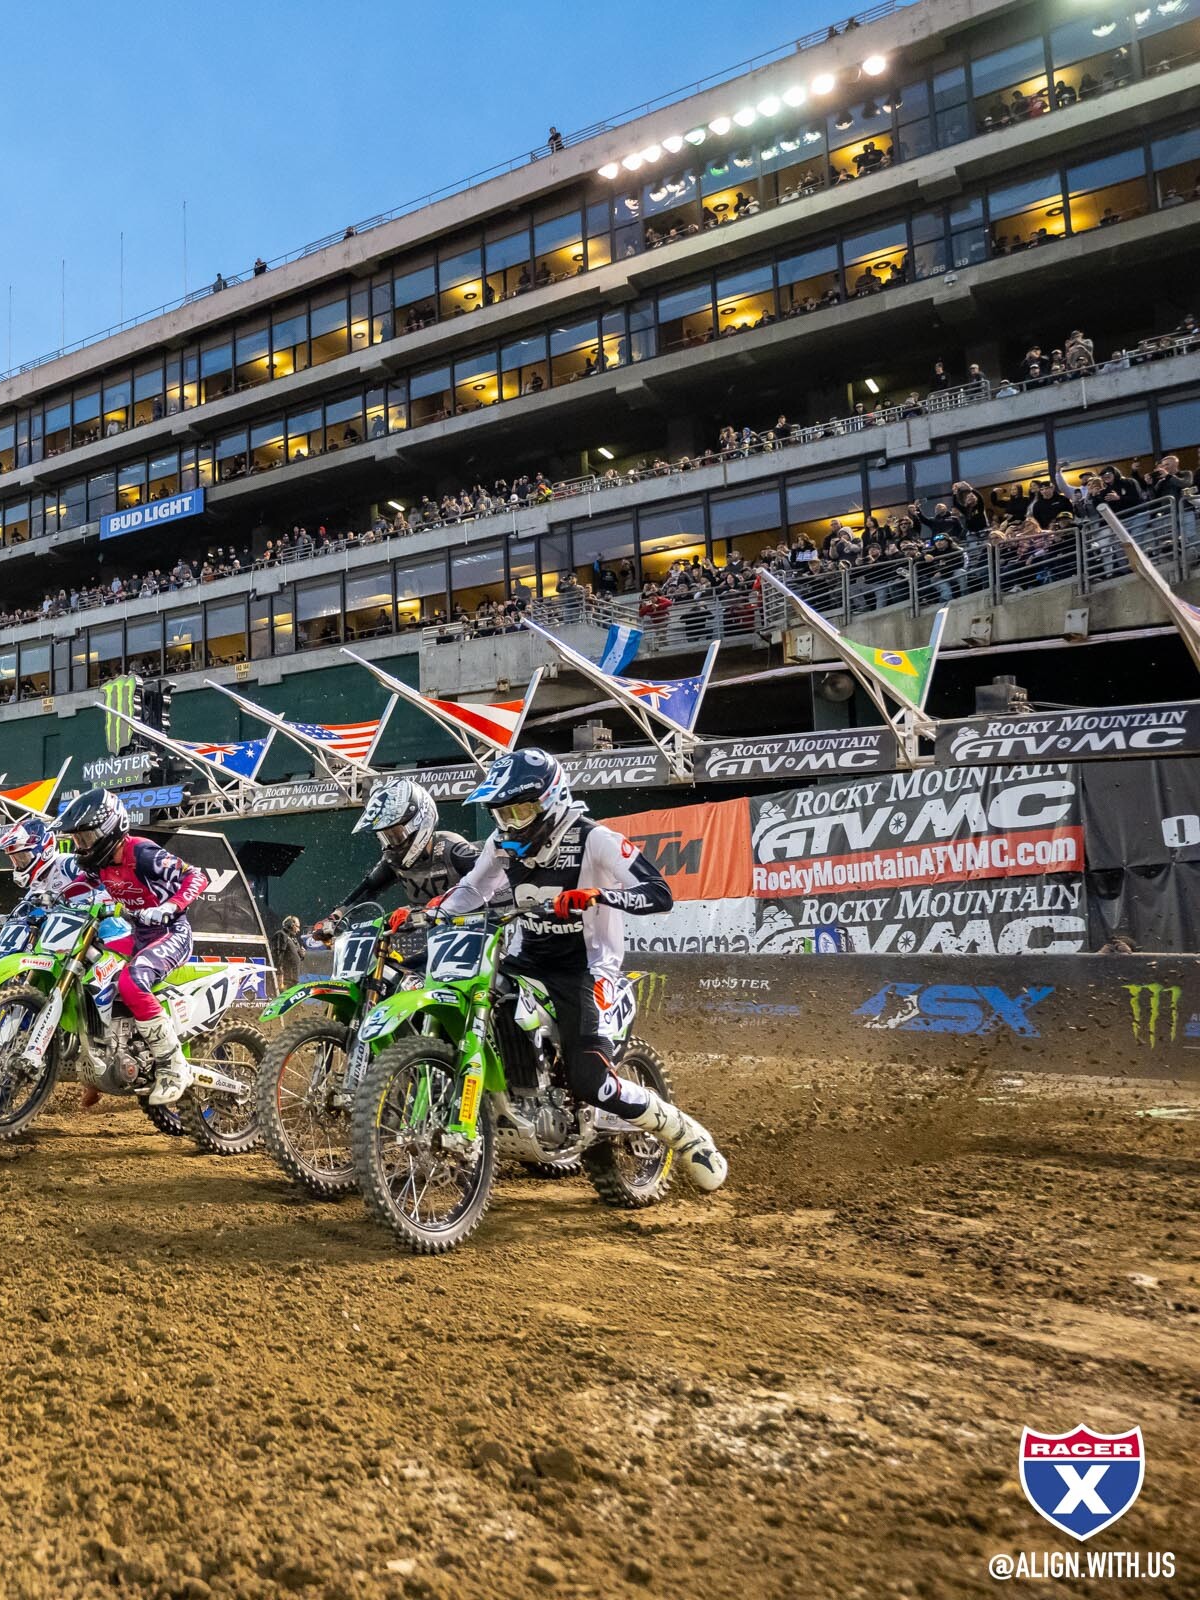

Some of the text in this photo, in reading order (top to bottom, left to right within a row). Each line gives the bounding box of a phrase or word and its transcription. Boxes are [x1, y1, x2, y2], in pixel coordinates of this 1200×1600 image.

[110, 496, 192, 532] BUD LIGHT
[983, 710, 1188, 737] ROCKY MOUNTAIN
[731, 735, 880, 758] ROCKY MOUNTAIN
[83, 754, 151, 779] MONSTER
[420, 769, 477, 783] MOUNTAIN
[560, 754, 658, 771] CKY MOUNTAIN
[93, 775, 140, 789] ENERGY
[265, 783, 339, 798] ROCKY MOUNTAIN
[792, 762, 1069, 819] ROCKY MOUNTAIN
[753, 836, 1077, 894] RockyMountainATVMC.com
[799, 882, 1083, 927] ROCKY MOUNTAIN
[42, 916, 83, 943] 17
[520, 918, 584, 935] nlyFans
[430, 933, 484, 972] 74
[205, 977, 229, 1015] 17
[699, 977, 771, 991] MONSTER
[612, 990, 634, 1031] 74
[354, 1042, 366, 1087] DUNLO
